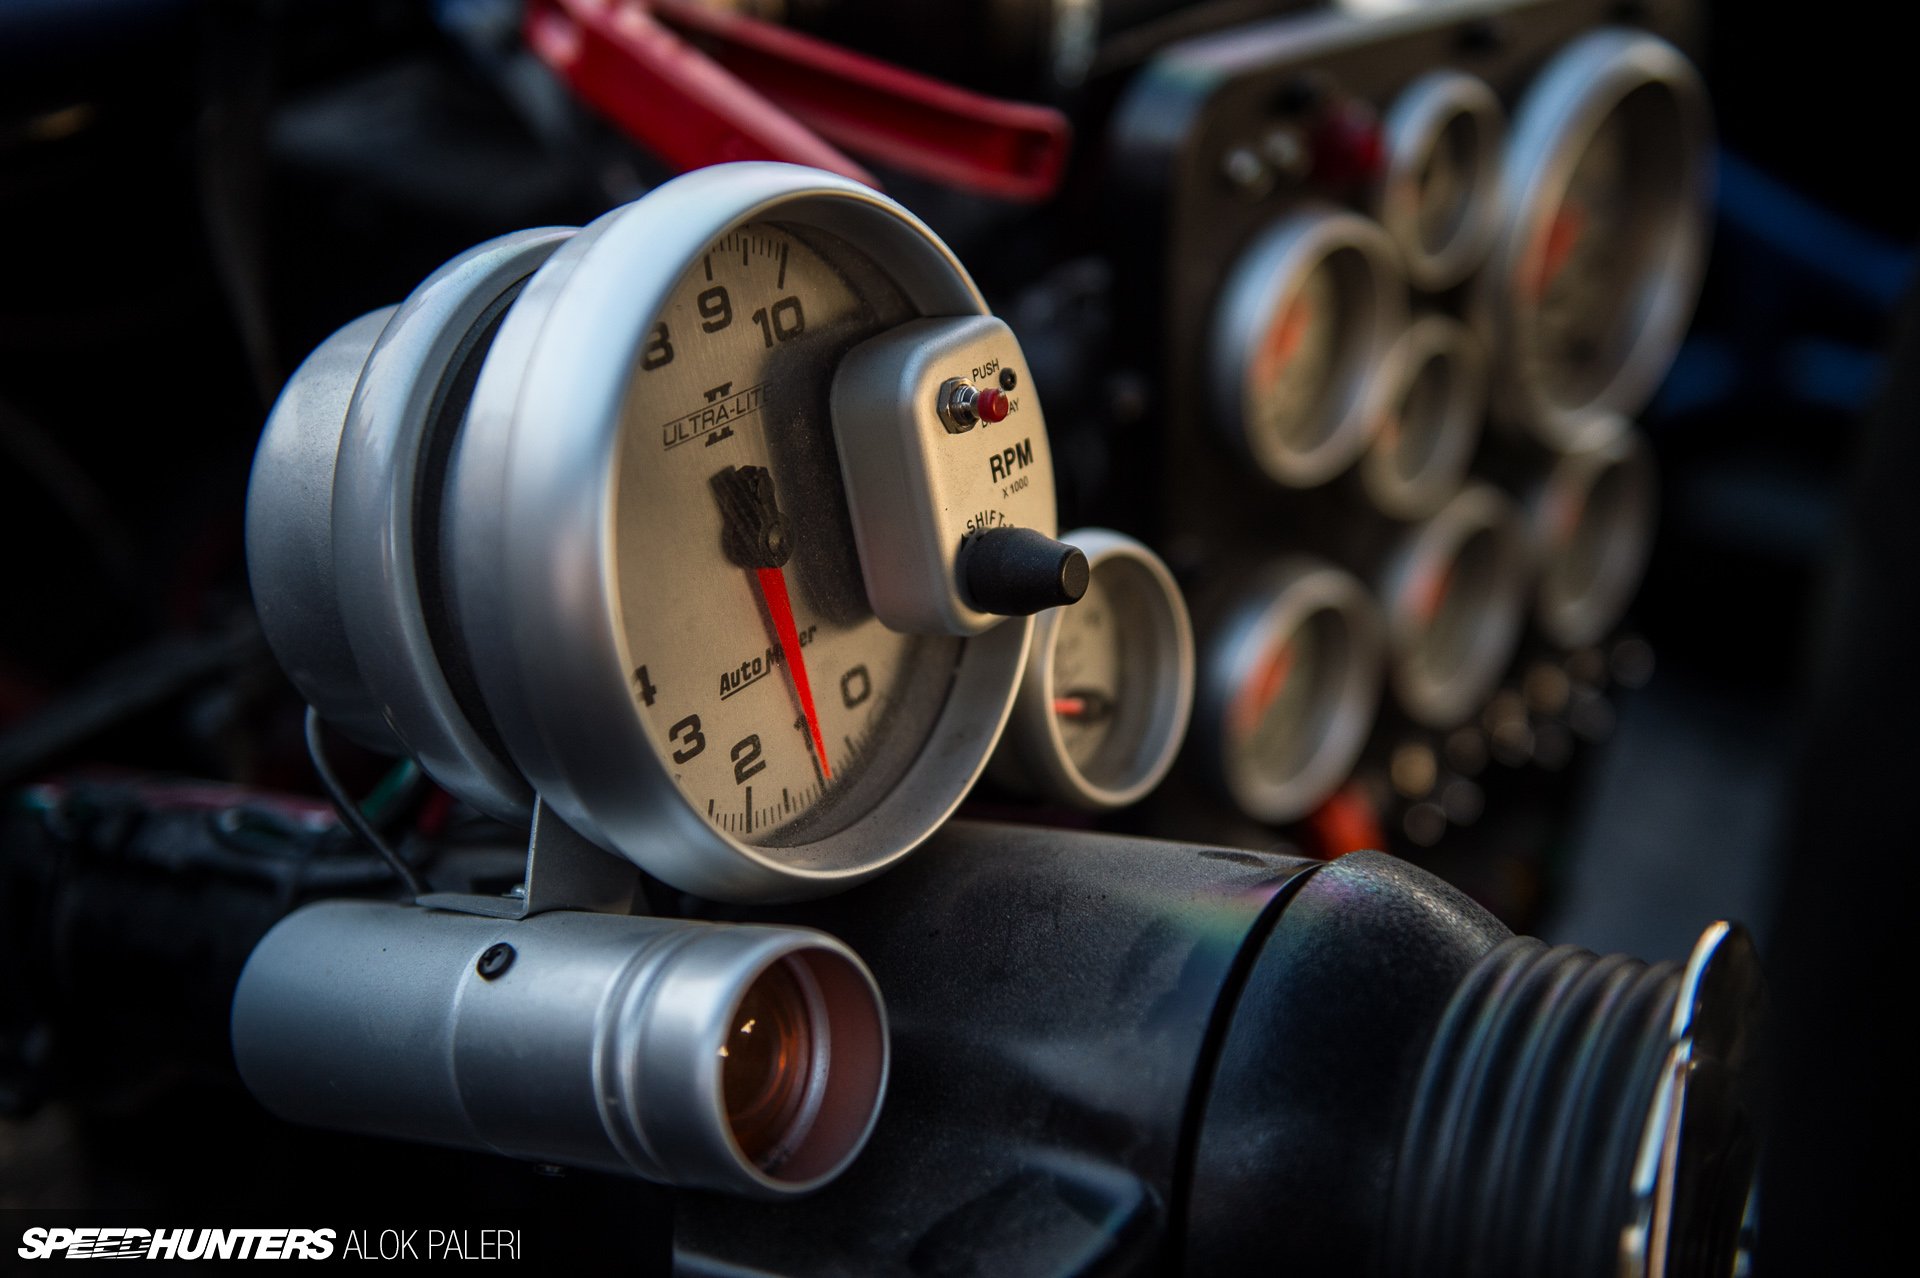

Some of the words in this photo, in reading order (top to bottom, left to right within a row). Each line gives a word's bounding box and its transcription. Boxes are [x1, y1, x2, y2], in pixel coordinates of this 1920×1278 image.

[697, 285, 733, 334] 9
[752, 295, 805, 348] 10
[640, 321, 674, 371] 8
[972, 358, 1000, 382] PUSH
[663, 383, 773, 447] ULTRA-LITE
[989, 437, 1034, 483] RPM
[1010, 475, 1029, 494] 1000
[966, 509, 1005, 535] SHIFT
[720, 656, 762, 696] Auto
[765, 625, 817, 673] Mer
[840, 664, 872, 710] 0
[669, 713, 706, 765] 3
[730, 733, 767, 786] 2
